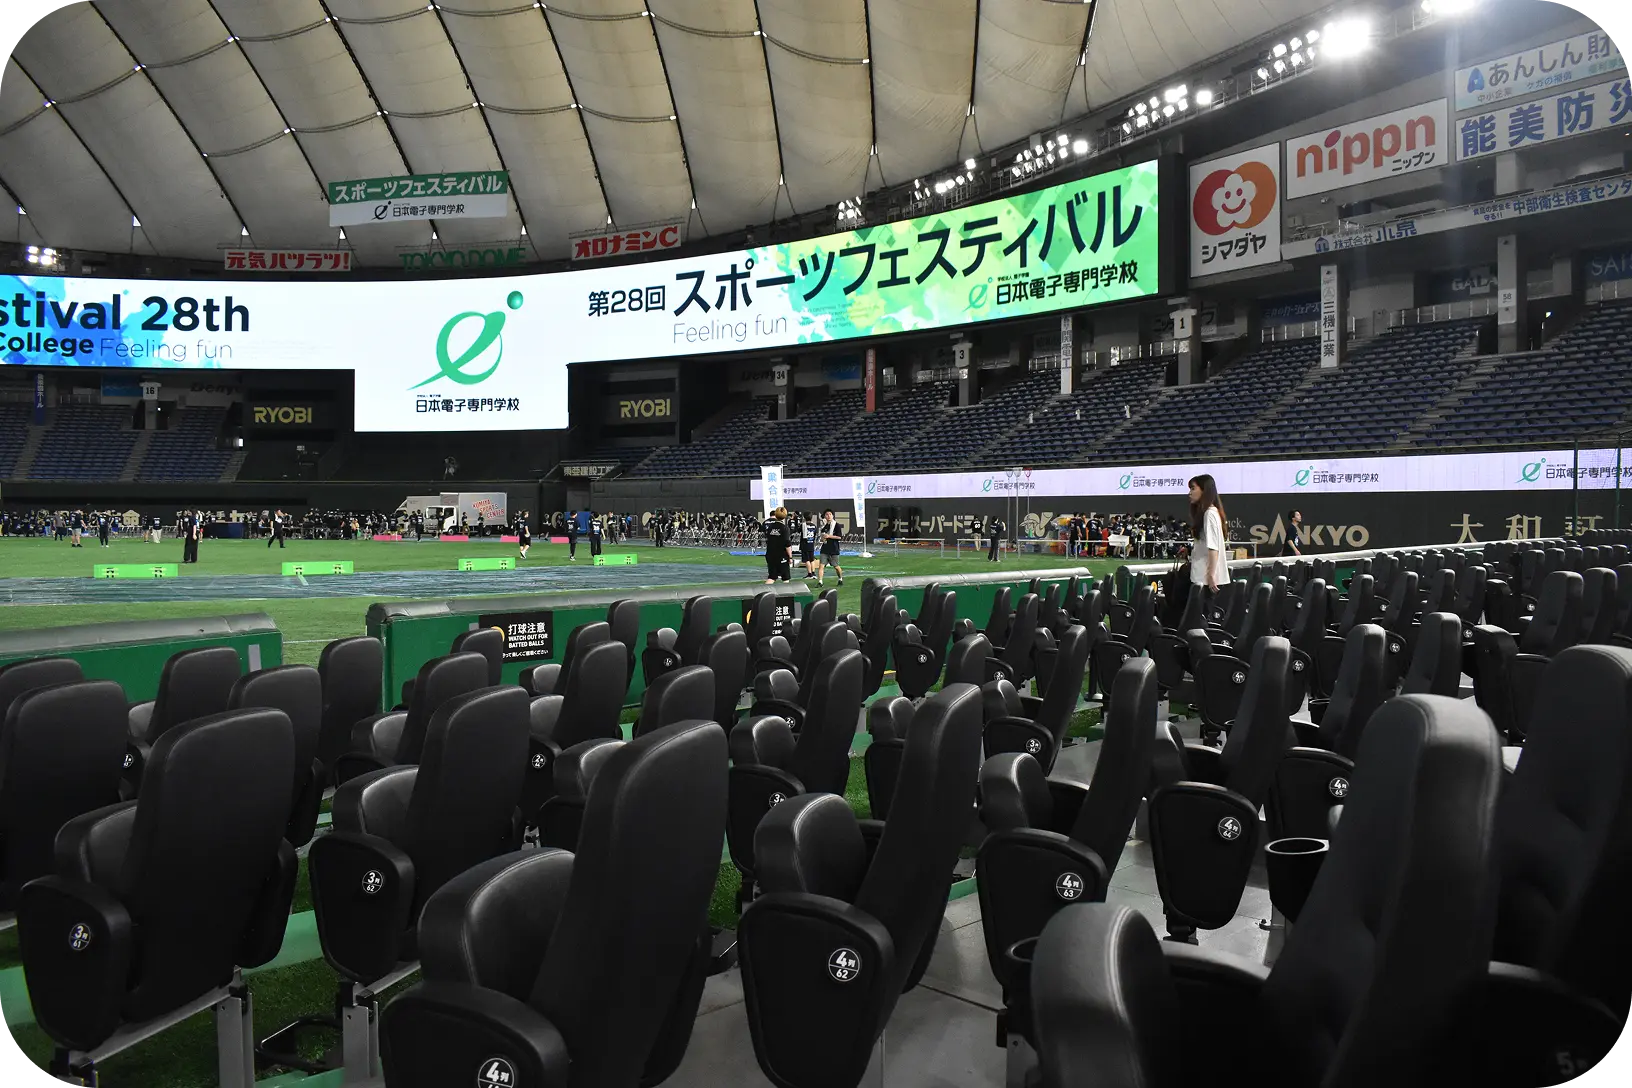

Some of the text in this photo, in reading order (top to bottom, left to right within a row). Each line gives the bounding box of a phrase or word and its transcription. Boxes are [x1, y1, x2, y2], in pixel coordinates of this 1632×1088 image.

[1488, 34, 1620, 87] あんしん財
[1296, 115, 1436, 178] nippn
[1392, 151, 1436, 172] ニップン
[335, 174, 503, 203] スポーツフェスティバル
[392, 203, 465, 217] 日本電子専門学校
[575, 226, 679, 259] オロナミンC
[1201, 232, 1267, 265] シマダヤ
[673, 185, 1144, 317] スポーツフェスティバル
[226, 251, 350, 270] 元気ハツラツ!
[1591, 253, 1632, 277] SAI
[996, 259, 1138, 305] 日本電子専門学校
[588, 285, 666, 317] 第28回
[141, 296, 250, 332] 28th
[673, 319, 747, 344] Feeling
[755, 314, 787, 336] fun
[1179, 317, 1185, 329] 1
[1322, 301, 1335, 357] 三機工業
[100, 338, 187, 362] Feeling
[197, 338, 233, 359] fun
[959, 349, 965, 360] 3
[776, 370, 786, 379] 34
[145, 387, 155, 395] 16
[416, 397, 520, 413] 日本電子専門学校
[619, 399, 671, 419] RYOBI
[253, 407, 313, 423] RYOBI
[1133, 478, 1184, 487] 日本電子専門学校
[1312, 473, 1379, 483] 日本電子専門学校
[876, 484, 911, 493] 日本電子専門学校
[775, 605, 789, 616] 注意
[508, 622, 546, 635] 打球注意
[1334, 779, 1347, 789] 4列
[1224, 819, 1239, 832] 4列
[1223, 830, 1232, 838] 64
[367, 871, 380, 884] 3列
[1062, 875, 1079, 888] 4列
[366, 884, 375, 892] 62
[1063, 889, 1074, 898] 63
[74, 925, 88, 940] 3列
[72, 938, 82, 949] 61
[835, 951, 856, 968] 4列
[836, 968, 848, 979] 62
[486, 1061, 509, 1083] 4列
